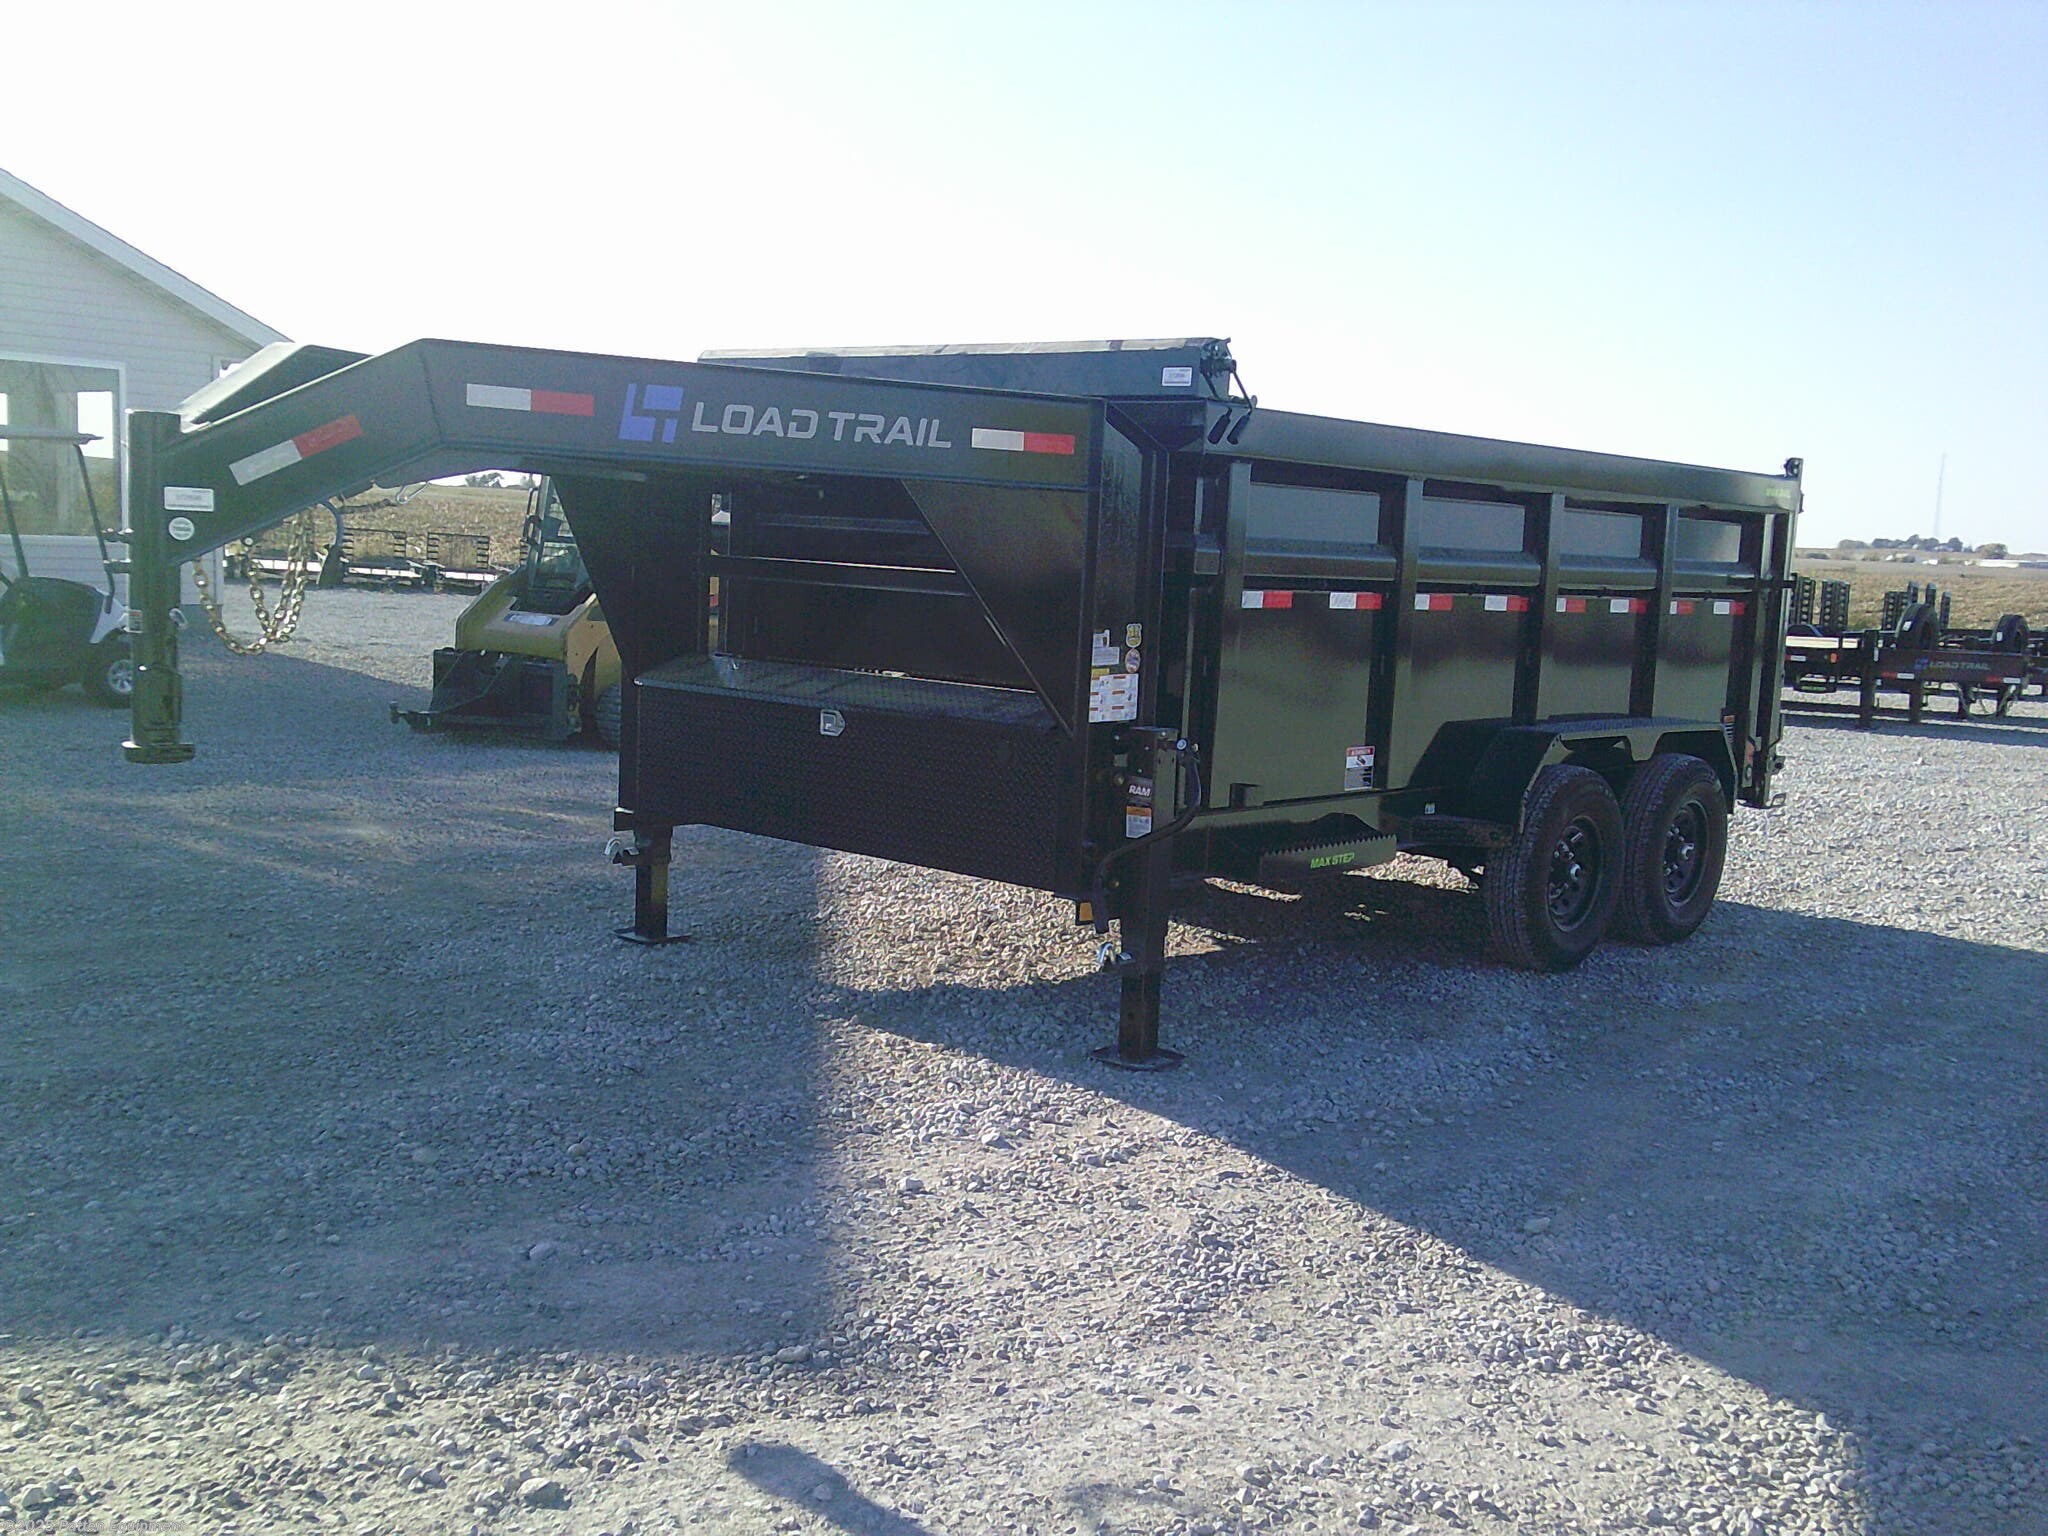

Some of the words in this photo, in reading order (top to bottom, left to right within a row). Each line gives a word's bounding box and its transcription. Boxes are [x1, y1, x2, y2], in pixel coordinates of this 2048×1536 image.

[691, 401, 819, 439] LOAD
[827, 411, 952, 449] TRAIL
[1129, 784, 1151, 797] RAM
[1311, 856, 1331, 869] MAX
[1332, 852, 1355, 865] STEP
